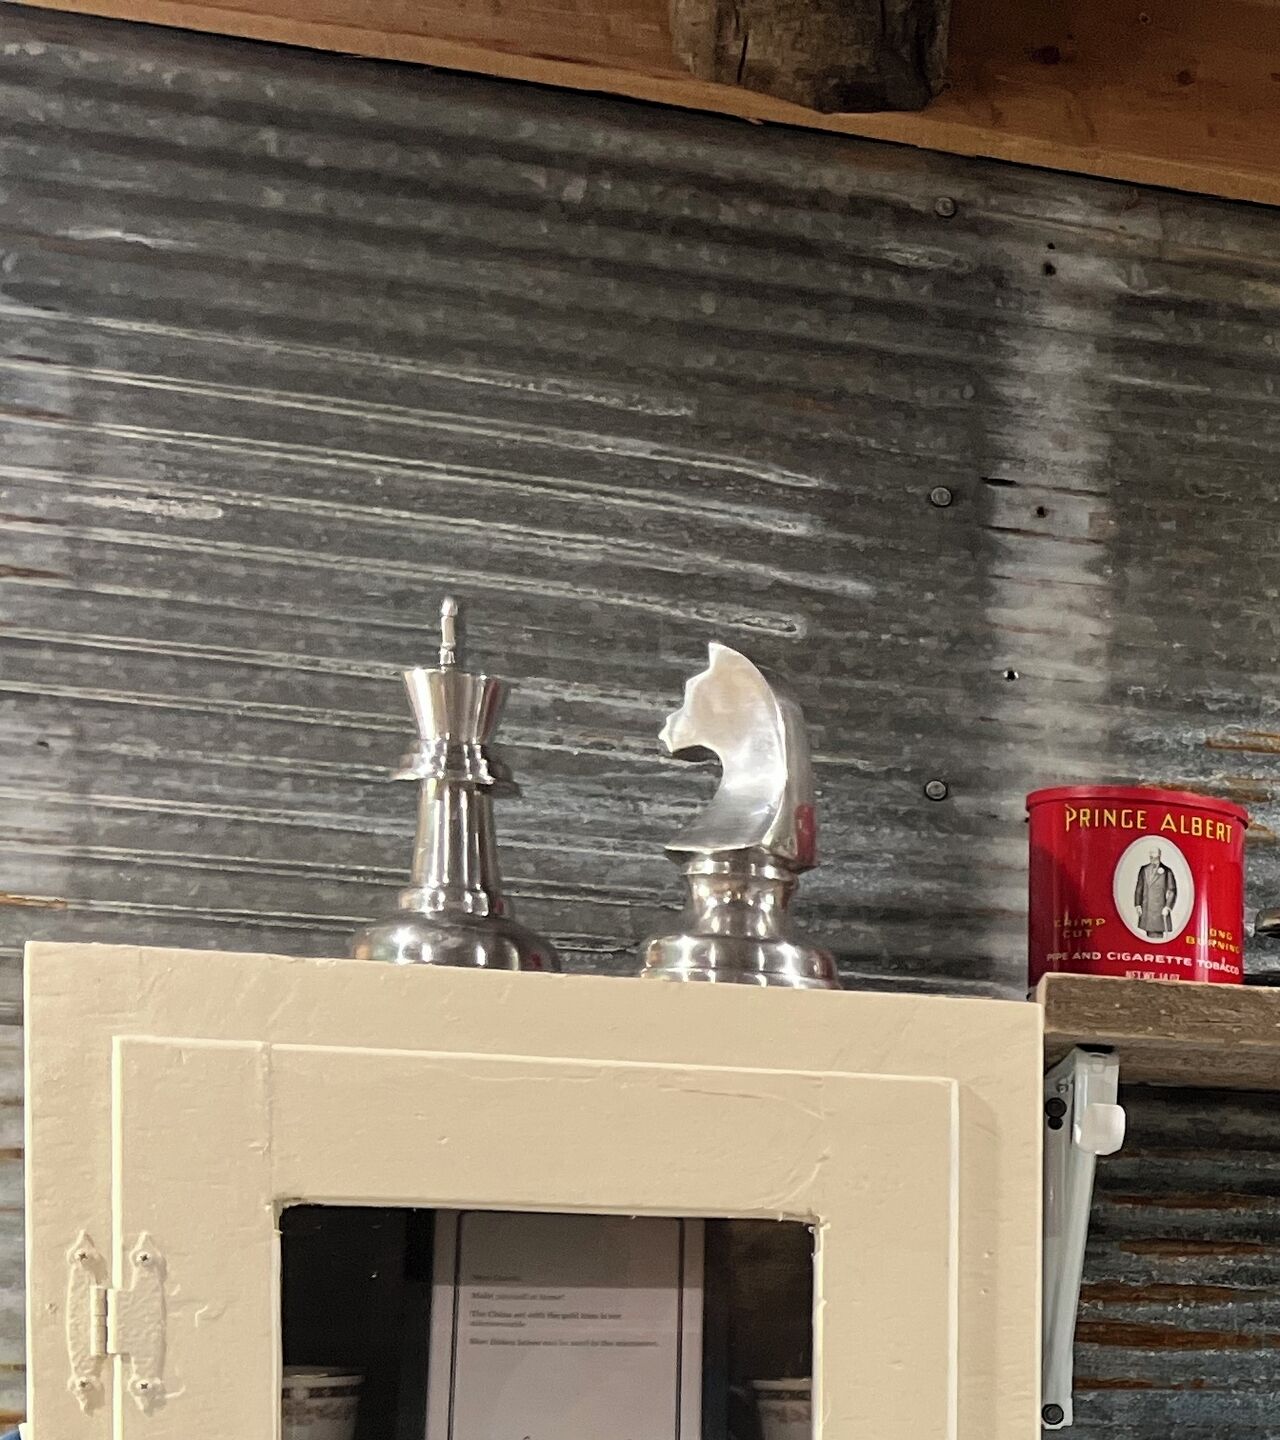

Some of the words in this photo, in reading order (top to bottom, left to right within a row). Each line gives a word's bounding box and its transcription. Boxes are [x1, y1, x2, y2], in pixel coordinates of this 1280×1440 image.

[1065, 804, 1147, 832] PRINCE
[1160, 813, 1233, 844] ALBERT
[1208, 928, 1233, 940] ONG
[1072, 951, 1101, 961] AND
[1106, 951, 1192, 967] CIGARETTE
[1197, 959, 1240, 976] TOBACCO
